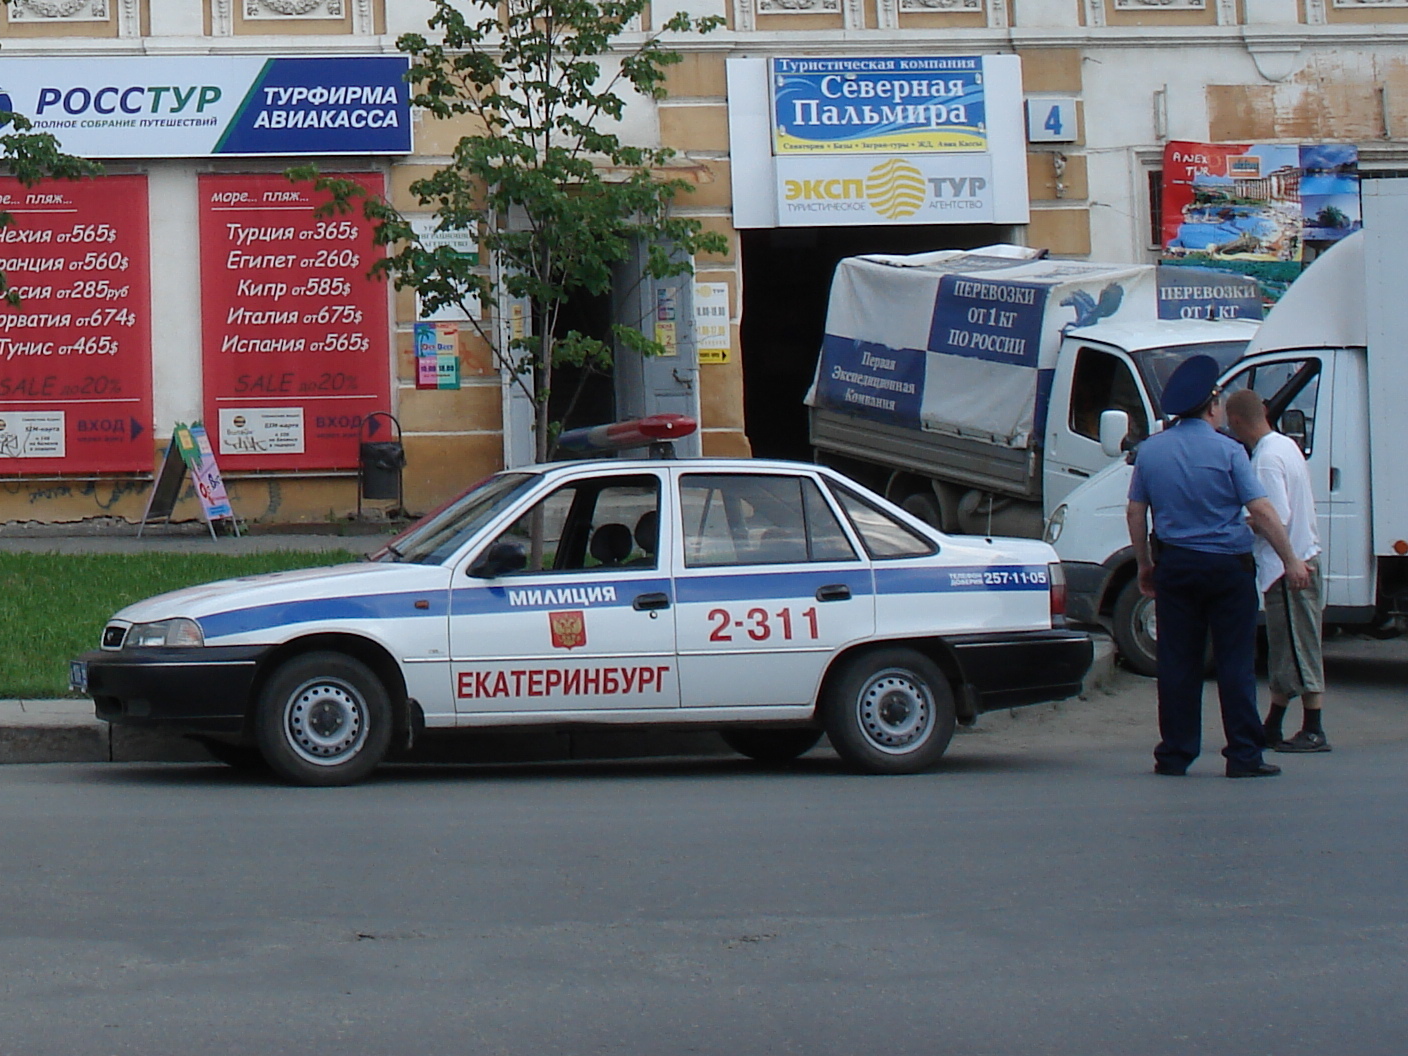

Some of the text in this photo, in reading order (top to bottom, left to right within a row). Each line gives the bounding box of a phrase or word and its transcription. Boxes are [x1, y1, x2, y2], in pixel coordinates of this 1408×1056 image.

[780, 57, 976, 72] Туристическая компания
[263, 86, 398, 106] ТУРФИРМА
[821, 75, 964, 103] Северная
[35, 86, 222, 115] РОССТУР
[33, 117, 218, 129] ПОЛНОЕ СОБРАНИЕ ПУТЕШЕСТВИЙ
[253, 109, 399, 129] АВИАКАССА
[792, 99, 968, 128] Пальмира
[1044, 105, 1063, 135] 4
[928, 177, 986, 198] ТУР
[787, 200, 983, 212] ТУРИСТИЧЕСКОЕ АГЕНТСТВО
[226, 223, 294, 245] Турция
[227, 250, 297, 269] Египет
[237, 279, 287, 301] Кипр
[953, 280, 1036, 305] ПЕРЕВОЗКИ
[1160, 285, 1256, 300] ПЕРЕВОЗКИ
[227, 307, 299, 325] Италия
[968, 307, 1018, 328] ОТ 1 КГ
[1180, 306, 1202, 319] ОТ
[1218, 305, 1239, 319] КГ
[221, 335, 306, 353] Испания
[947, 328, 1027, 356] ПО РОССИИ
[861, 351, 897, 371] Первая
[235, 373, 295, 393] SALE
[78, 419, 125, 433] ВХОД
[509, 586, 618, 607] МИЛИЦИЯ
[707, 606, 820, 642] 2-311
[457, 666, 671, 699] ЕКАТЕРИНБУРГ
